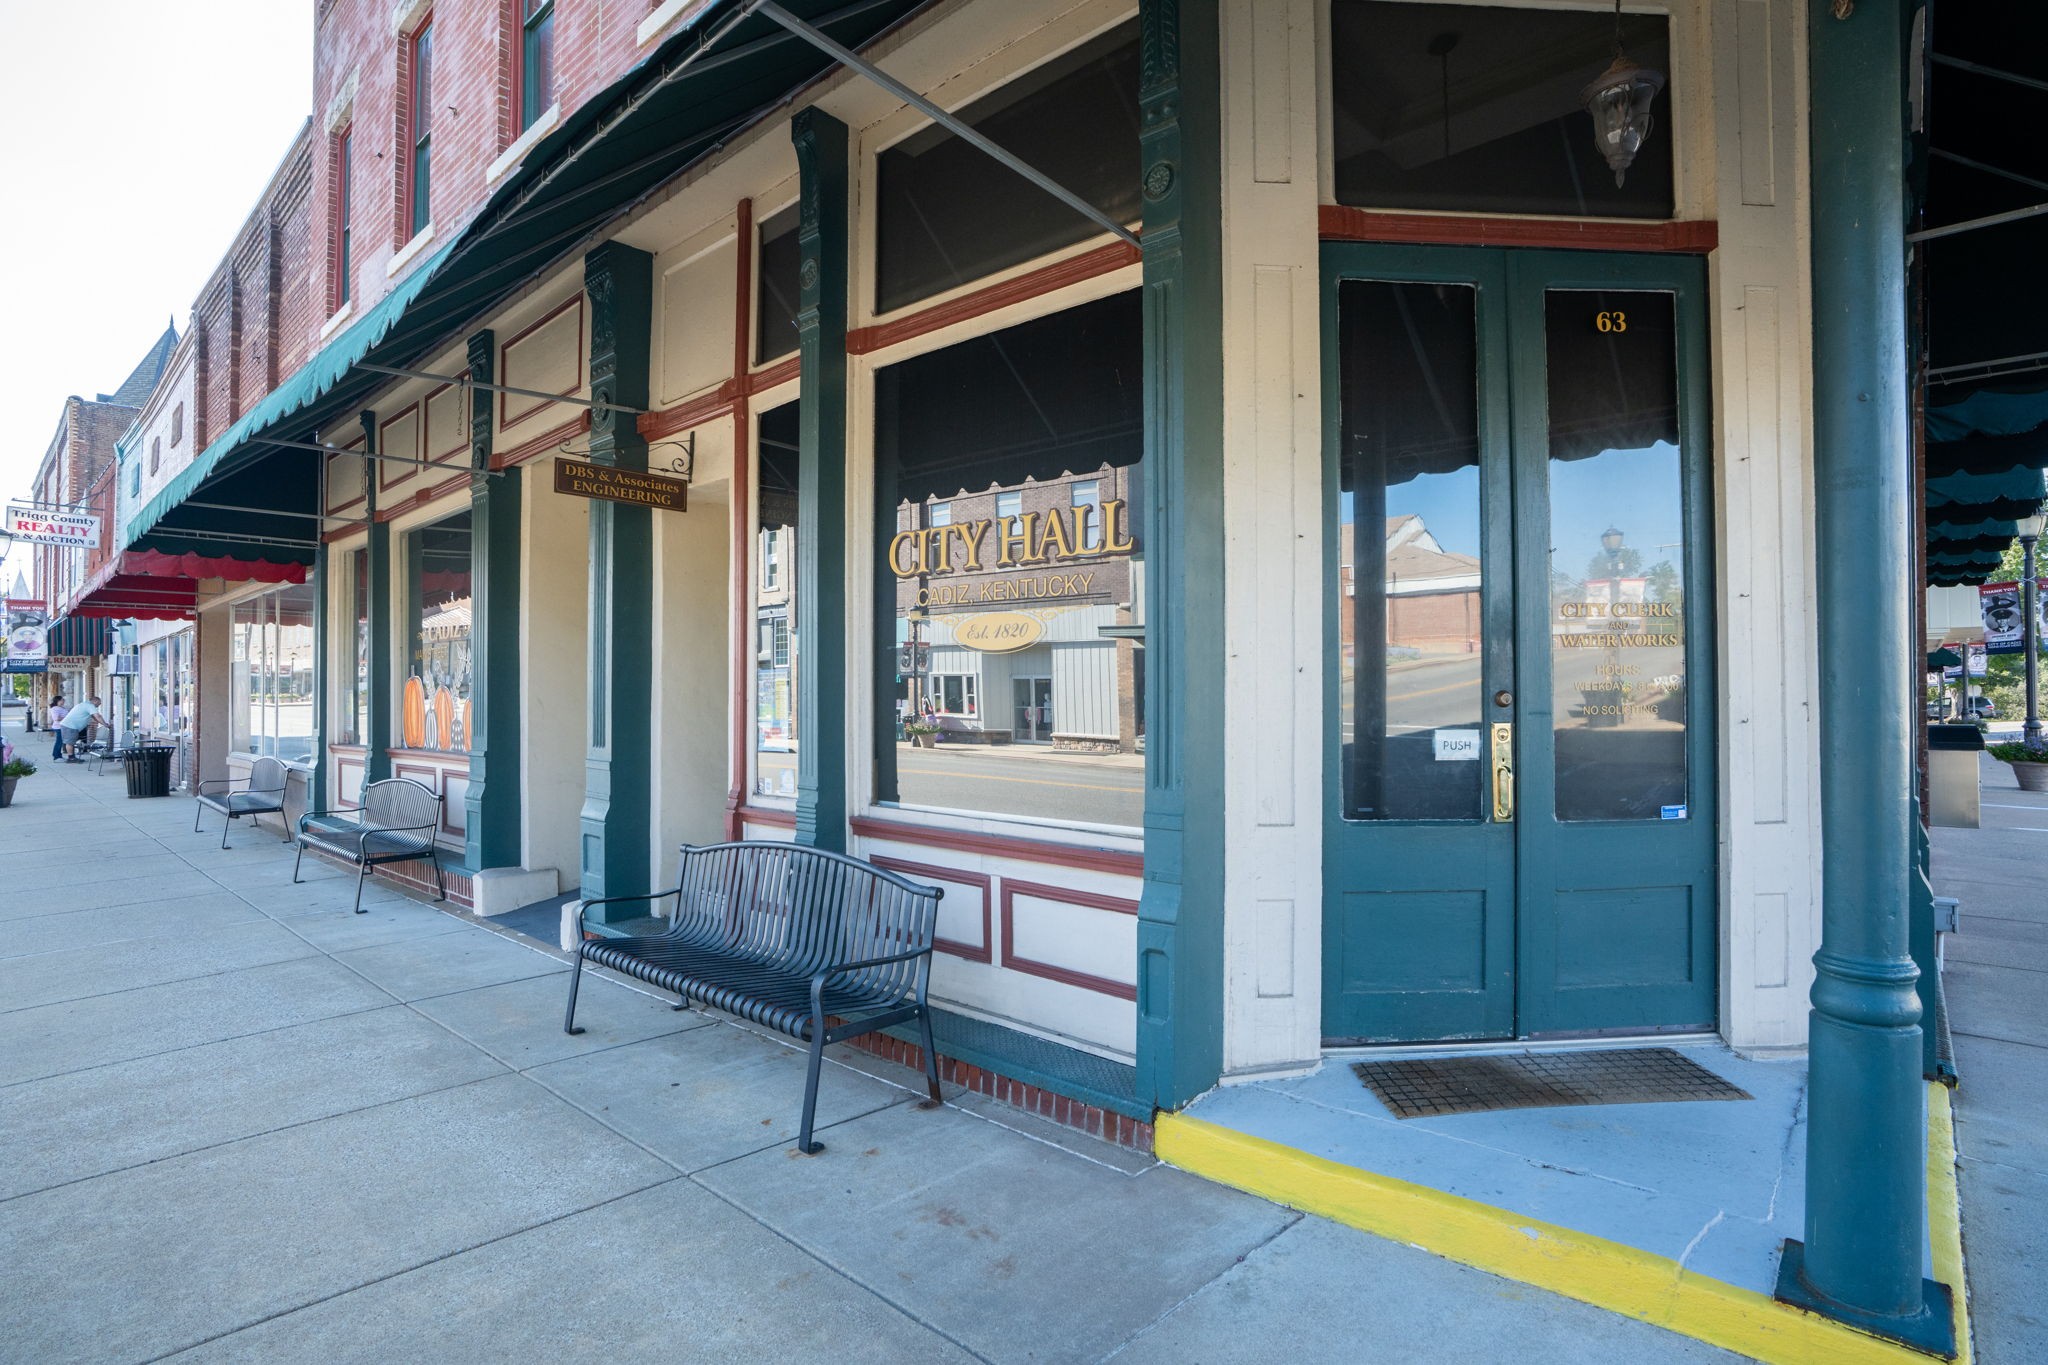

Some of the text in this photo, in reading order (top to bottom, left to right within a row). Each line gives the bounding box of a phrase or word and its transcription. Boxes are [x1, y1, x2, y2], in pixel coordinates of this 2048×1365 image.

[1596, 311, 1627, 332] 63
[565, 464, 680, 493] DBS & Associates
[573, 480, 671, 505] ENGINEERING
[12, 509, 96, 527] Trigg County
[17, 520, 91, 537] REALTY
[36, 534, 85, 545] AUCTION
[888, 499, 1136, 579] CITY HALL
[916, 573, 1095, 606] CADIZ, KENTUCKY
[1561, 603, 1674, 617] CITY CLERK
[966, 622, 1029, 640] Est. 1820
[1608, 622, 1629, 630] AND
[1560, 634, 1679, 648] WATER WORKS
[1574, 681, 1633, 691] WEEKDAYS
[1583, 705, 1659, 715] NO SOLICITING
[1443, 740, 1472, 751] PUSH
